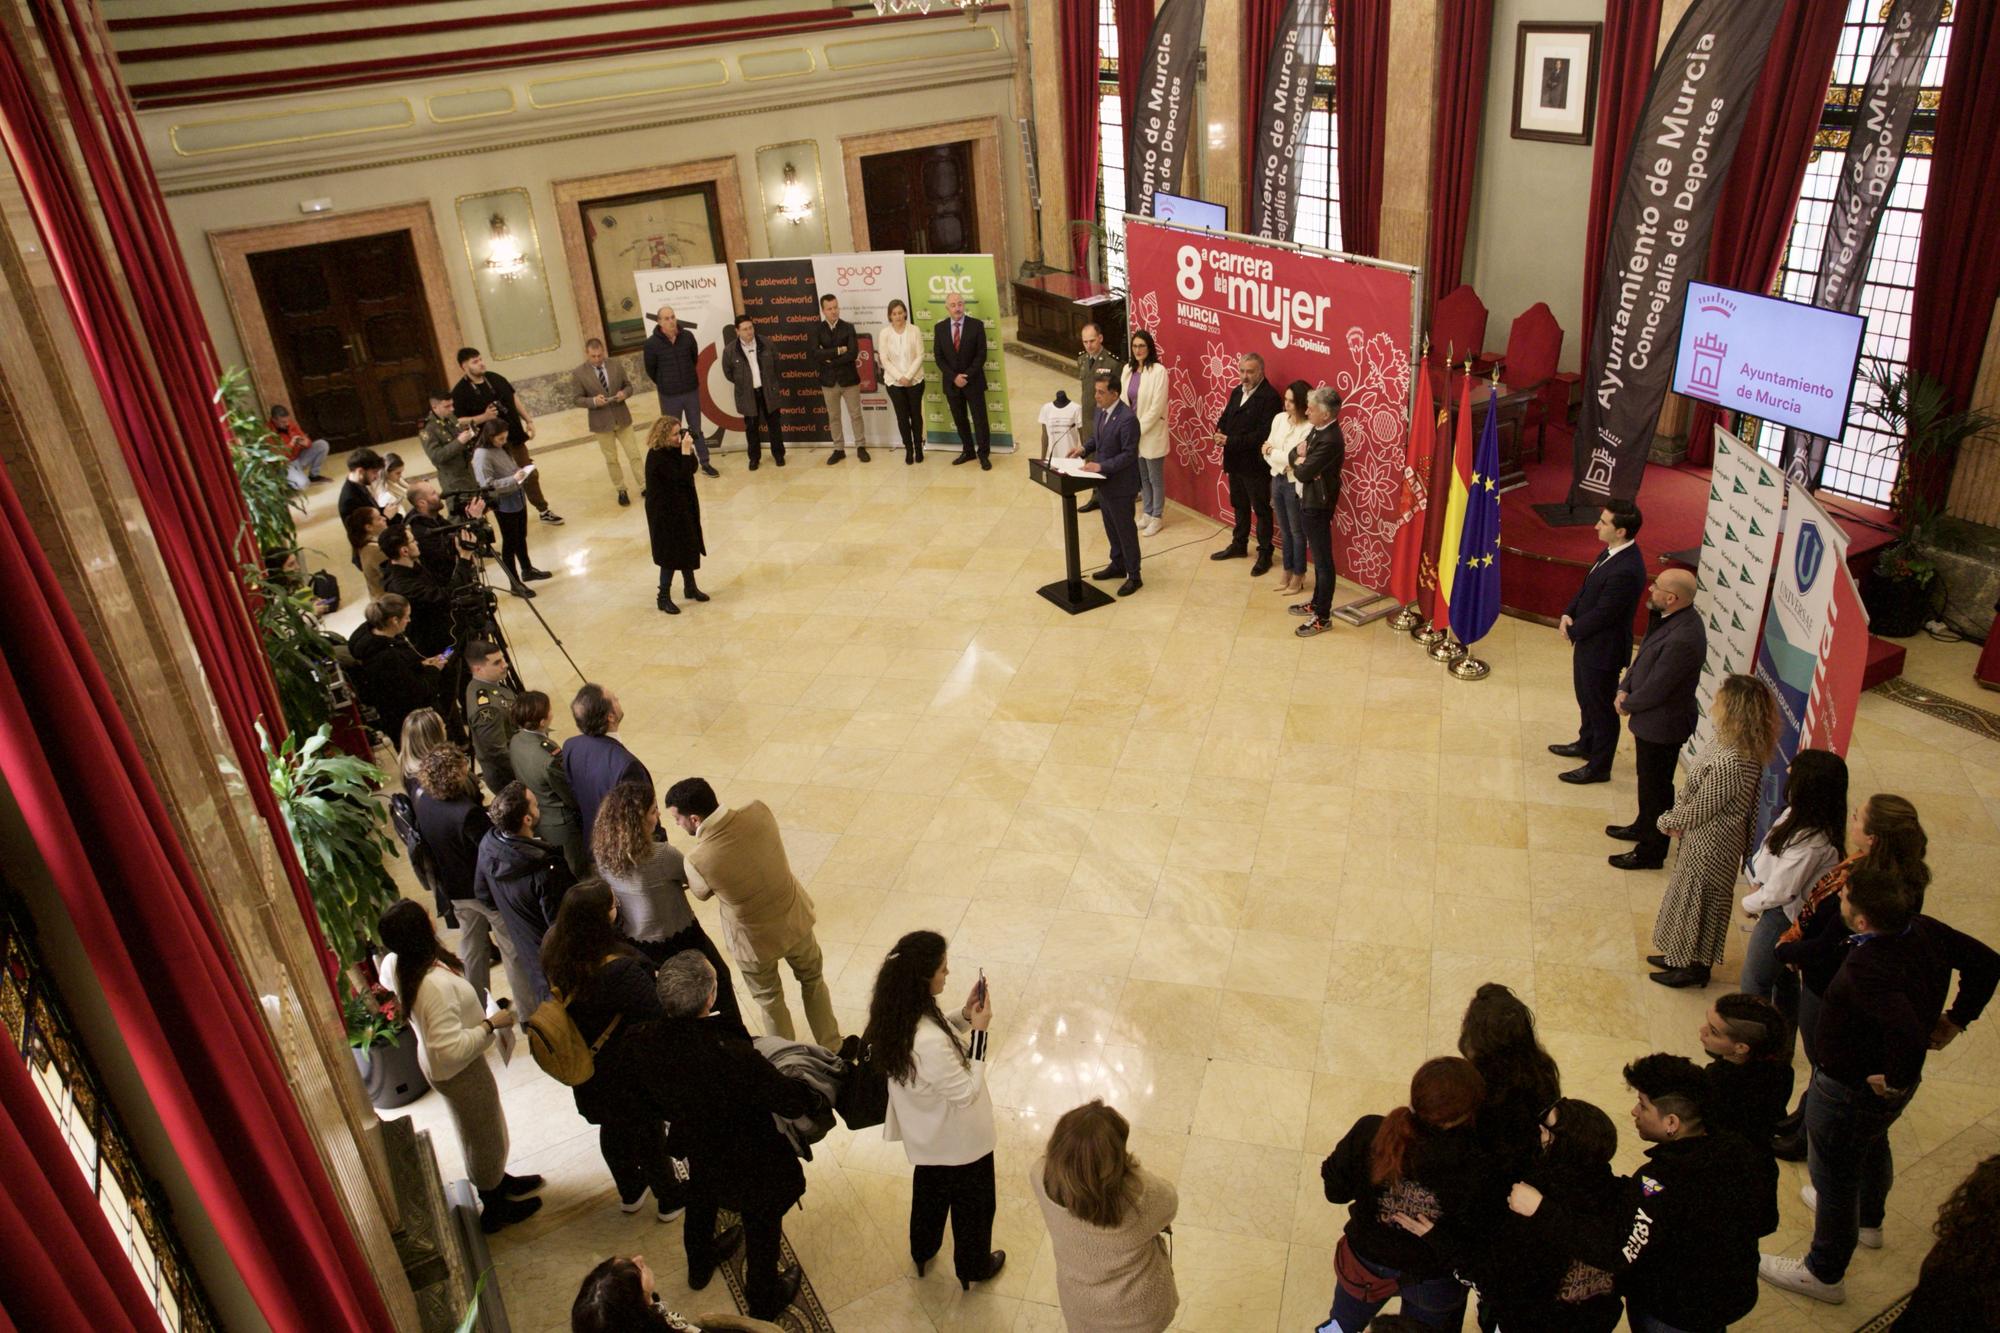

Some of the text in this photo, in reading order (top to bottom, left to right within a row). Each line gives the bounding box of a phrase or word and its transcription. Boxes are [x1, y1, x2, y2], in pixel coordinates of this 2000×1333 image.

[1161, 76, 1181, 153] Deportes
[1144, 116, 1161, 144] de
[1260, 31, 1298, 242] amiento de Murcia
[1139, 150, 1157, 217] miento
[1159, 158, 1172, 179] de
[1275, 189, 1289, 243] cejalía
[1598, 32, 1716, 410] Ayuntamiento de Murcia
[1629, 96, 1724, 371] Concejalía de Deportes
[1825, 194, 1862, 304] miento
[1209, 249, 1274, 282] carrera
[649, 282, 664, 293] La
[755, 277, 798, 287] cableworld
[928, 275, 975, 294] CRC
[770, 296, 813, 305] cableworld
[1177, 302, 1220, 327] MURCIA
[1228, 275, 1331, 350] mujer
[769, 334, 808, 342] ableworld
[1189, 320, 1207, 332] MARZO
[781, 370, 820, 379] cableworl
[1740, 362, 1834, 399] Ayuntamiento
[780, 406, 806, 415] eworld
[1737, 384, 1801, 414] de Murcia
[1622, 1207, 1654, 1264] RUGBY
